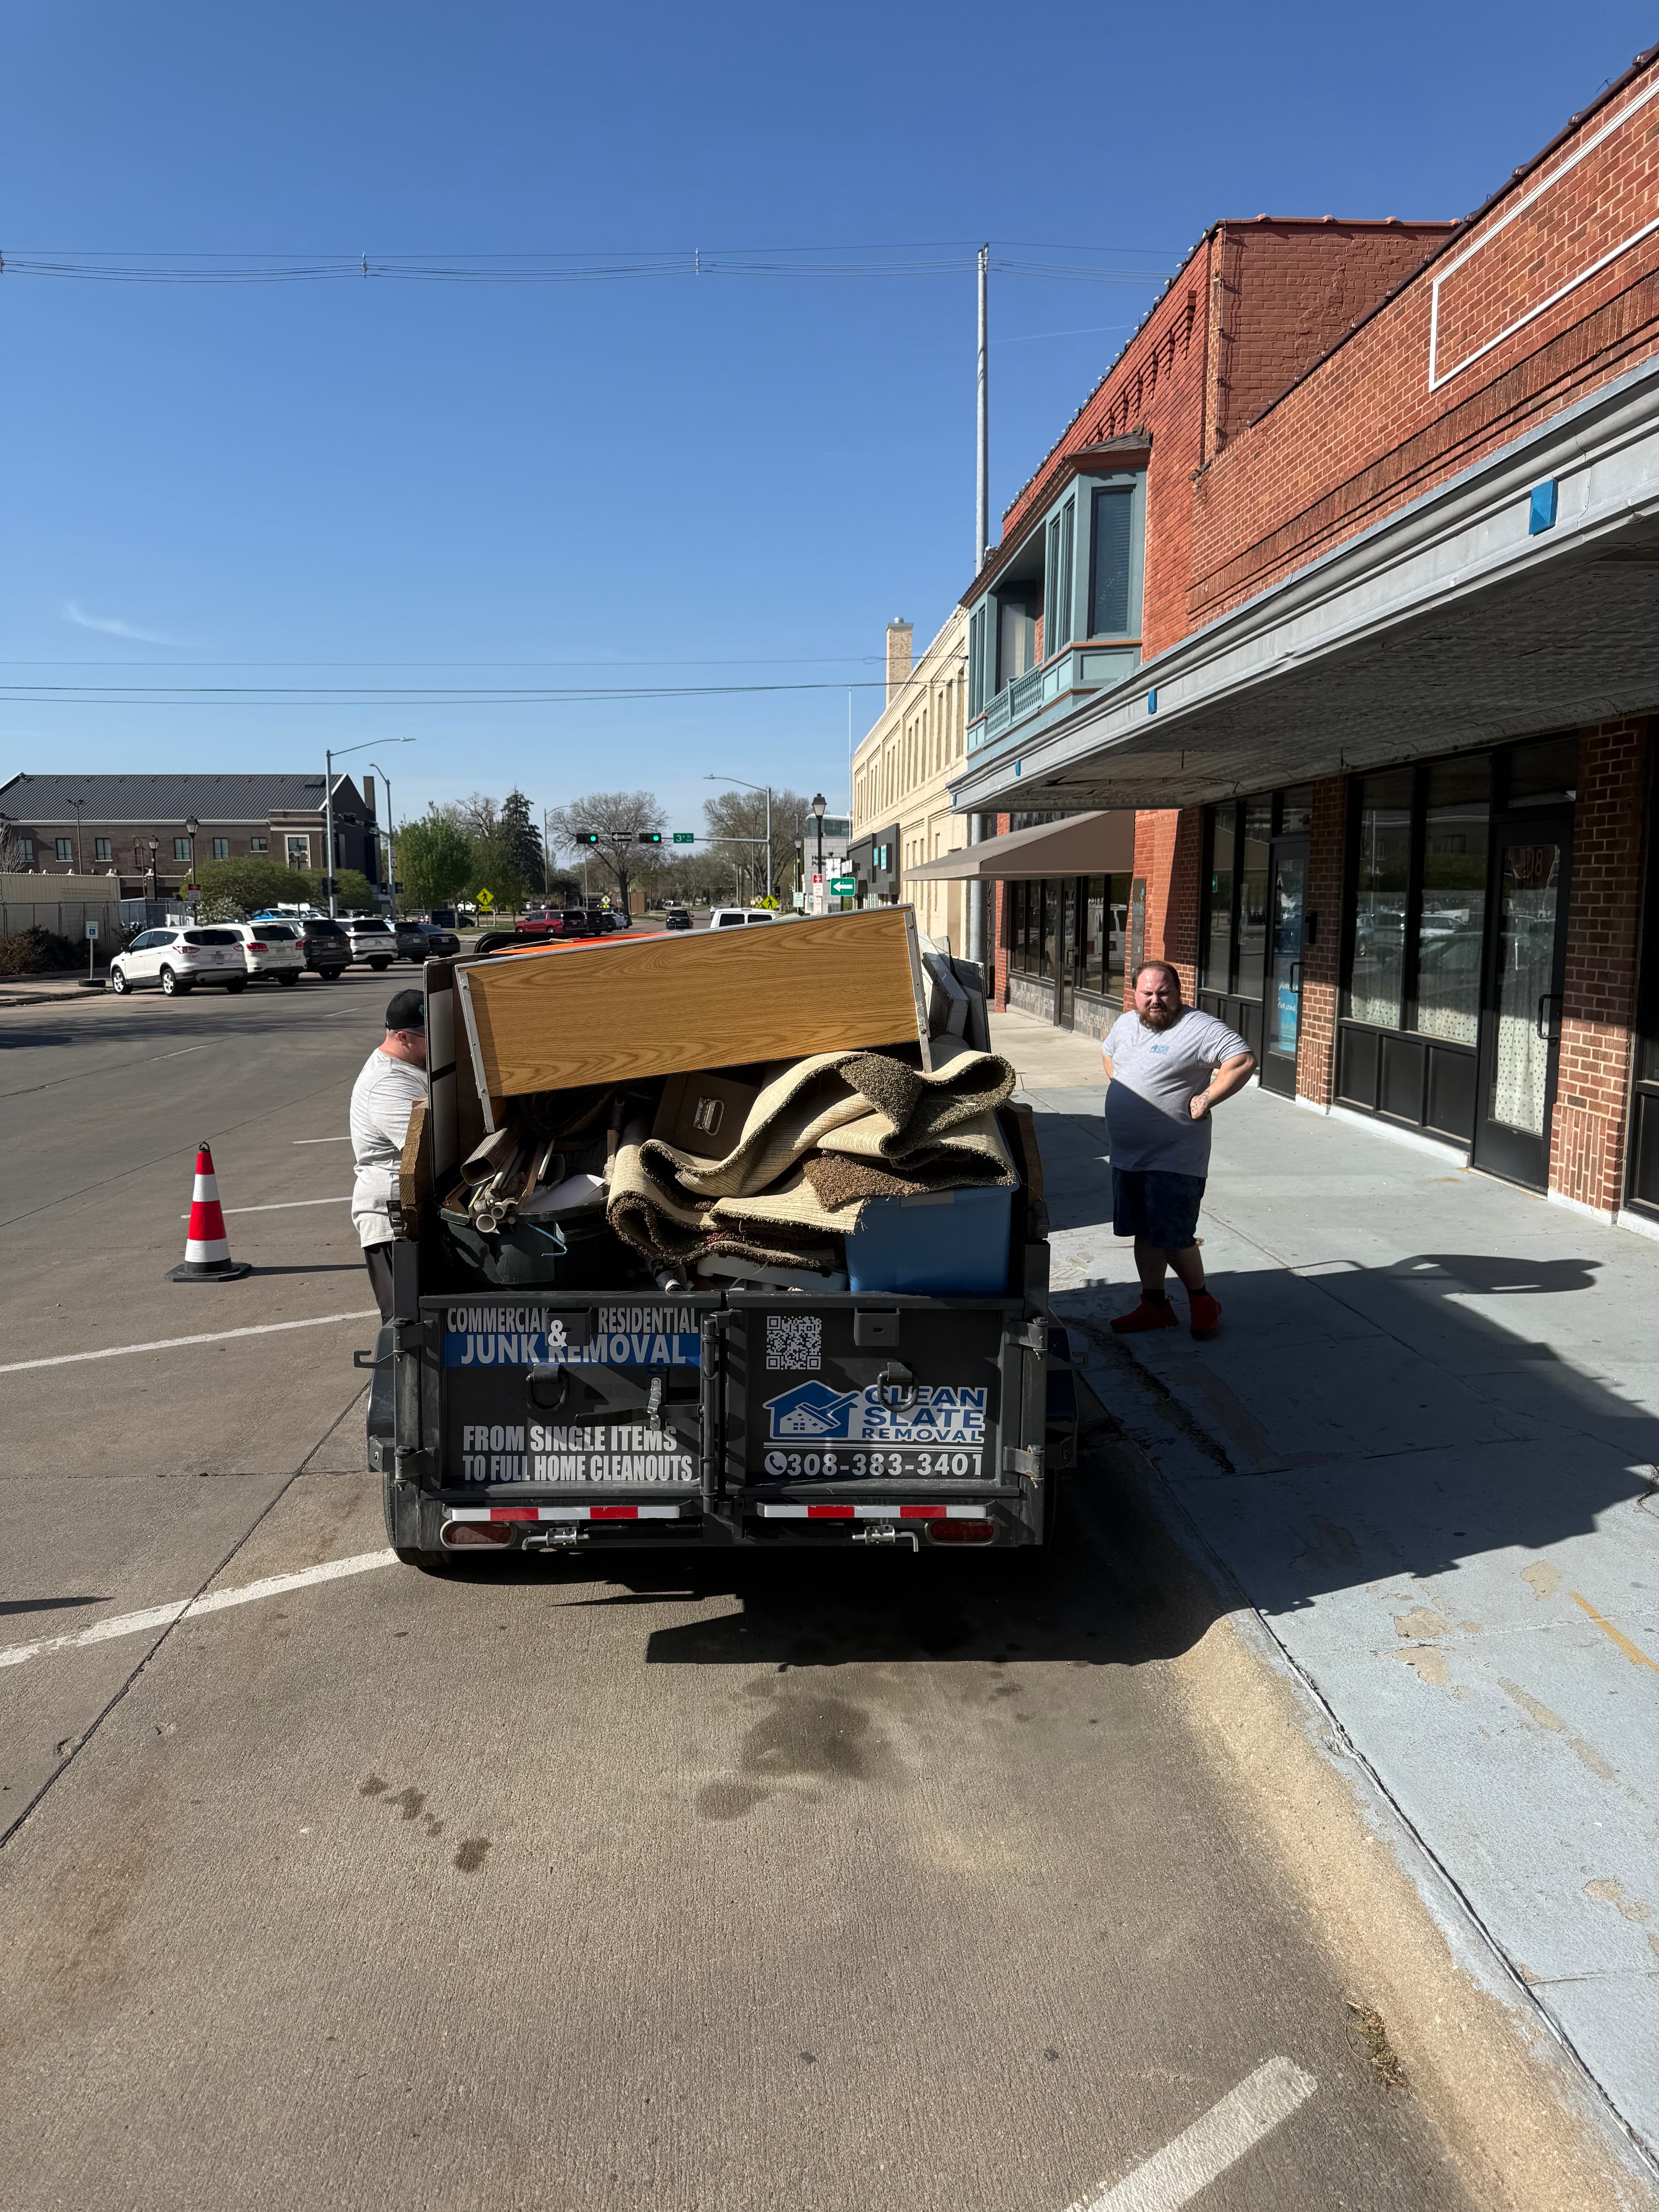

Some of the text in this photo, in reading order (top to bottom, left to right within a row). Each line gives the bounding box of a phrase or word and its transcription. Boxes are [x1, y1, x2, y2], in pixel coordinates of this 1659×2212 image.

[548, 1319, 567, 1347] &
[598, 1307, 699, 1333] RESIDENTIAL
[461, 1334, 686, 1364] JUNK REMOVAL
[864, 1386, 984, 1408] CLEAN
[863, 1406, 983, 1428] SLATE
[463, 1425, 677, 1451] FROM SINGLE ITEMS
[862, 1427, 982, 1441] REMOVAL
[462, 1455, 692, 1481] TO FULL HOME CLEANOUTS
[787, 1452, 982, 1476] 308-383-3401
